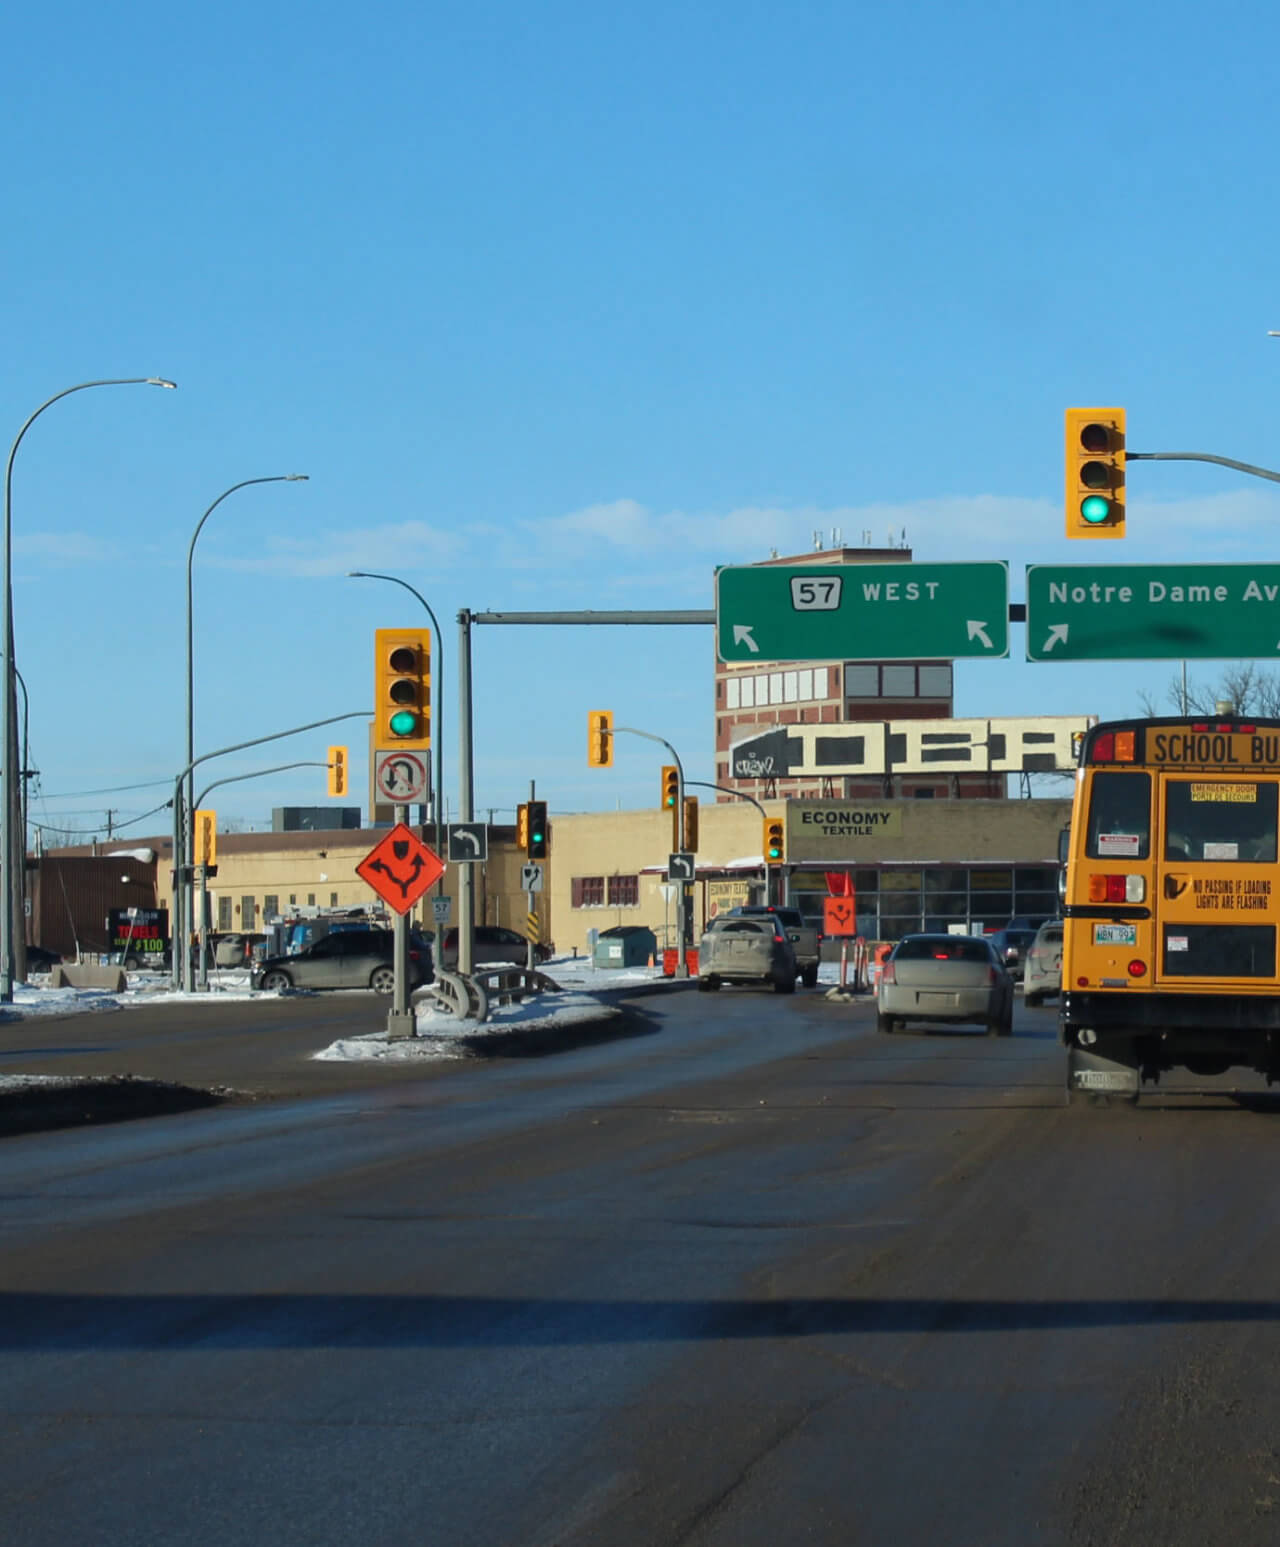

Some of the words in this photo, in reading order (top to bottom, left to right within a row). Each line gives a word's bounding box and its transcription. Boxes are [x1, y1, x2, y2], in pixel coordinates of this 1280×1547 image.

[800, 583, 835, 604] 57
[863, 582, 939, 601] WEST
[1050, 582, 1133, 603] Notre
[1149, 581, 1228, 602] Dame
[1155, 734, 1238, 763] SCHOOL
[802, 811, 890, 825] ECONOMY
[822, 826, 873, 836] TEXTILE
[1193, 879, 1203, 894] NO
[1205, 879, 1233, 894] PASSING
[1236, 880, 1241, 893] IF
[1244, 879, 1271, 895] LOADING
[1196, 895, 1219, 909] LIGHTS
[1222, 895, 1234, 909] ARE
[1236, 895, 1267, 910] FLASHING
